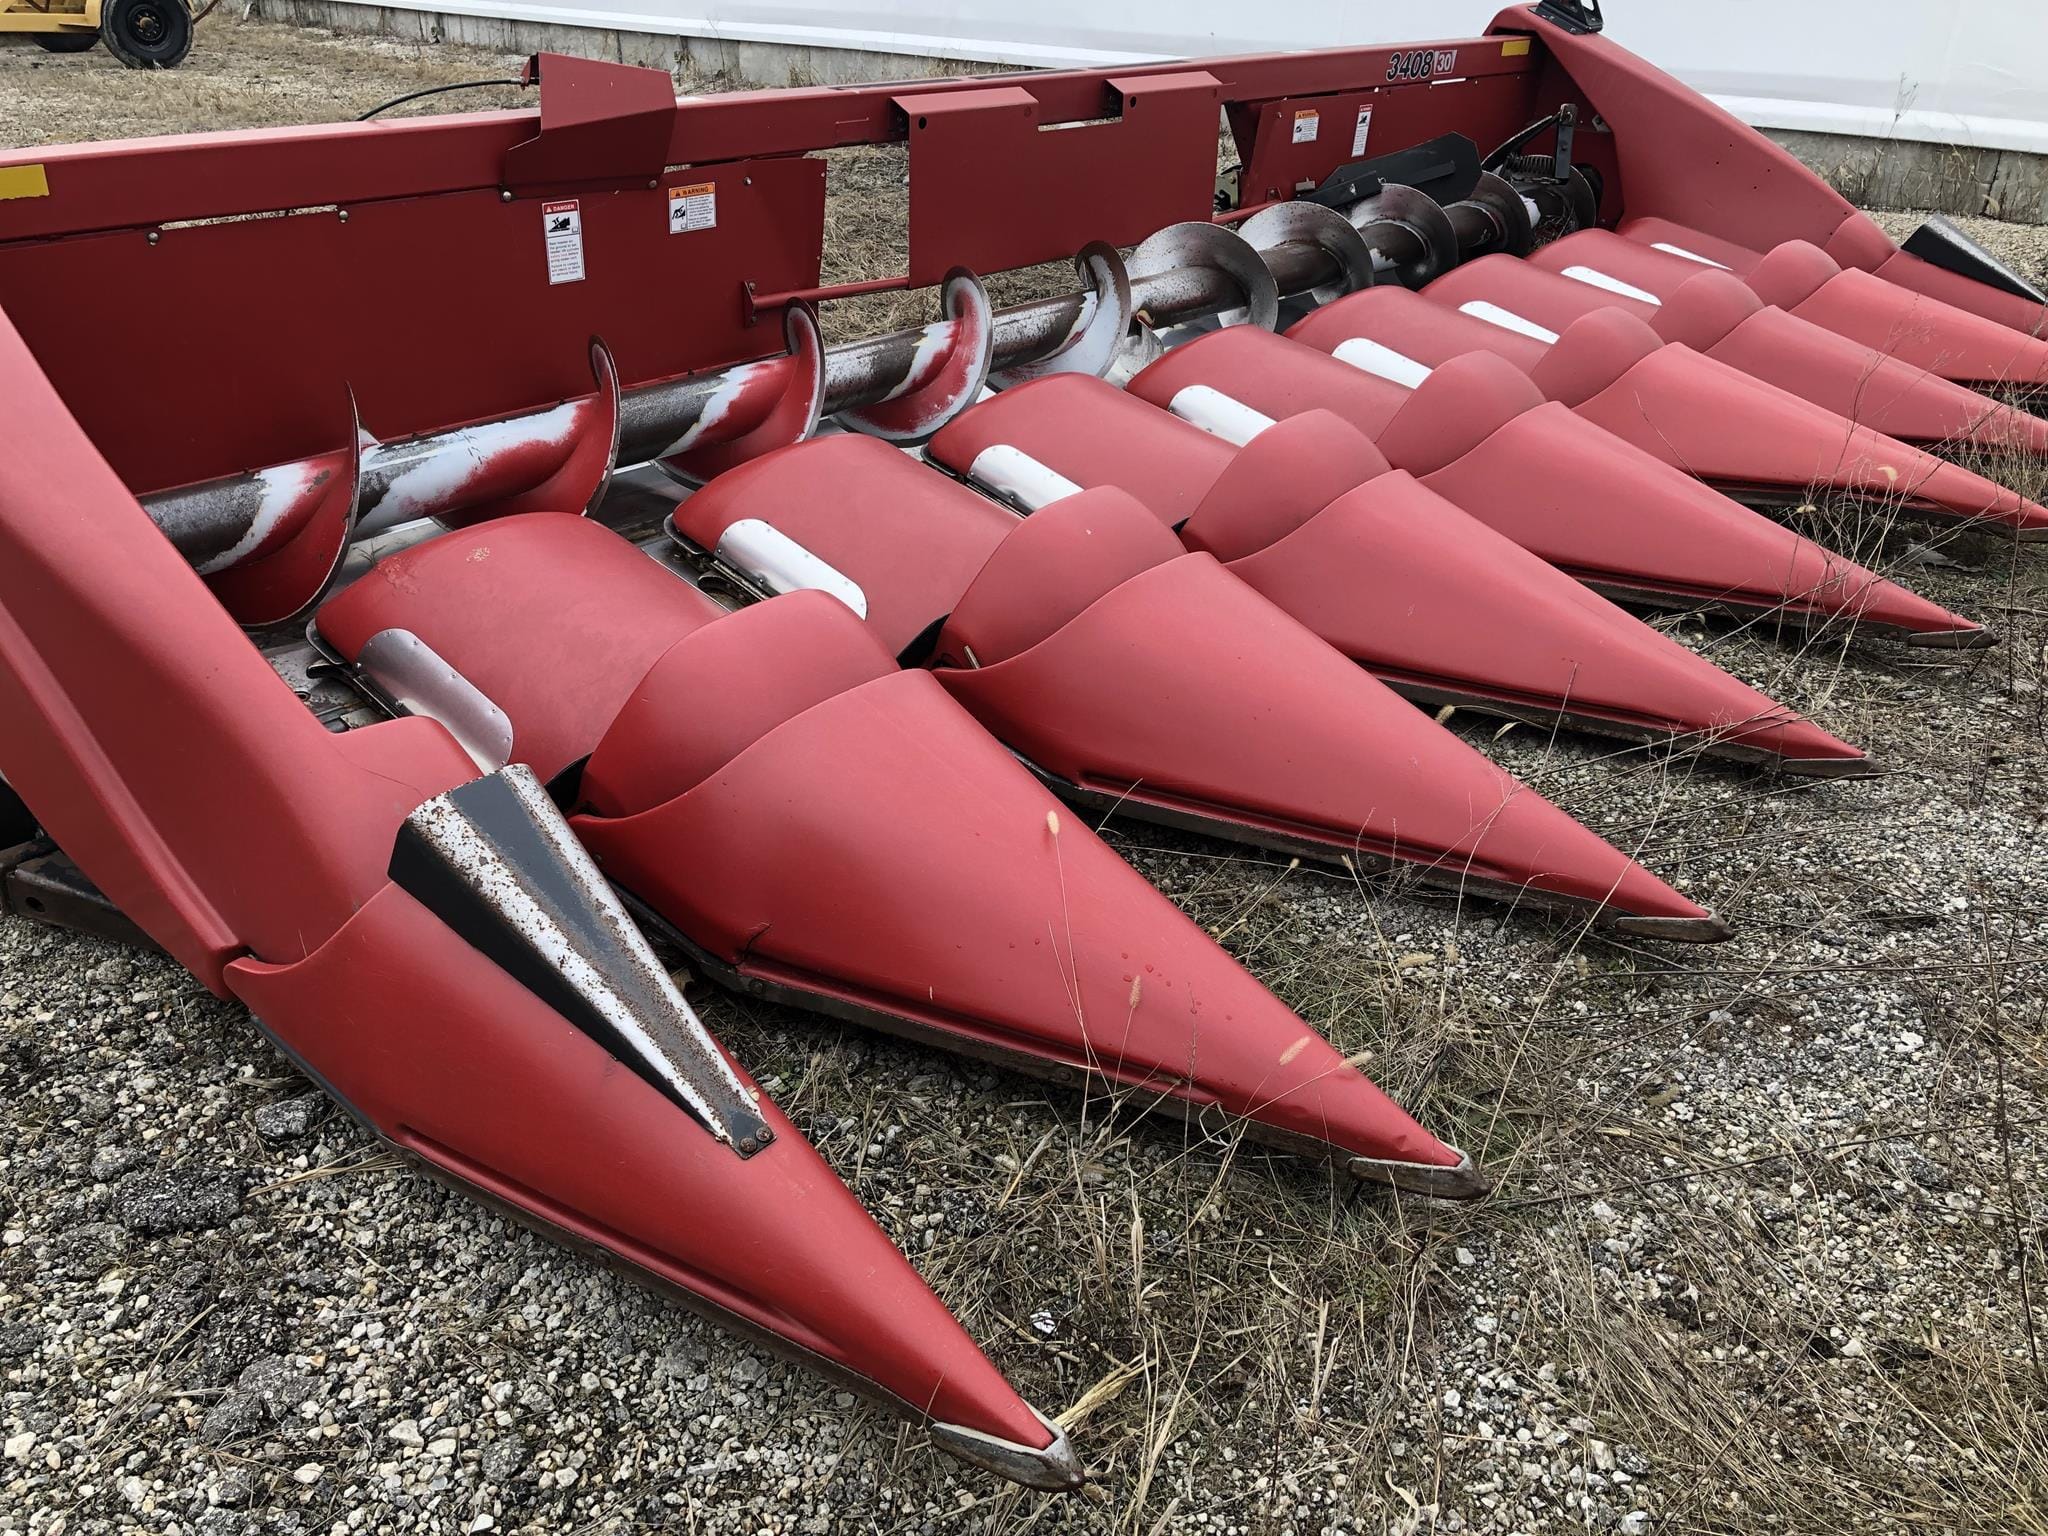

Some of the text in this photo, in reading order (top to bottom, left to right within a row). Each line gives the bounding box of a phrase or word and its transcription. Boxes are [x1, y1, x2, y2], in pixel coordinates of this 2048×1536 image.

[1386, 50, 1452, 81] 3408 30
[682, 186, 709, 195] WARNING
[552, 204, 575, 212] DANGER
